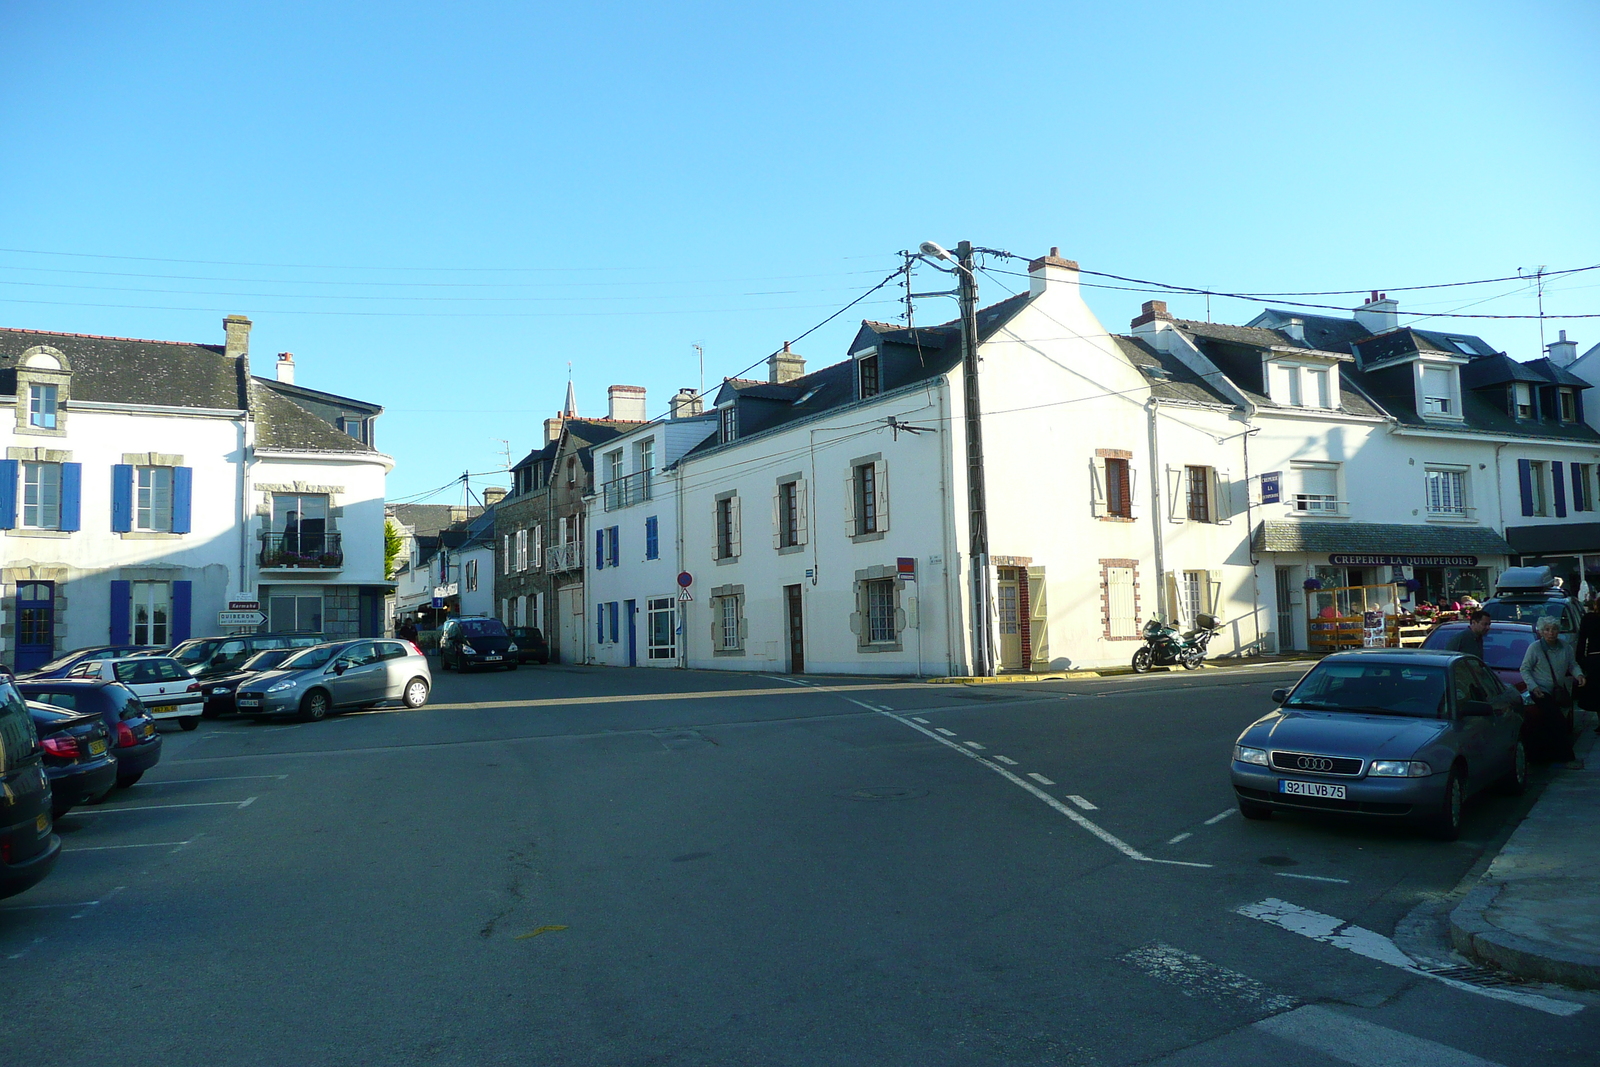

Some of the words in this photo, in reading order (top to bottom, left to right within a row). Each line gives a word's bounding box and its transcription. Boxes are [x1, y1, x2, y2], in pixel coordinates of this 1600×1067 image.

[1334, 555, 1386, 565] CREPERIE
[1390, 555, 1402, 565] LA
[1406, 556, 1474, 567] QUIMPEROISE
[1287, 782, 1305, 794] 921
[1308, 784, 1328, 796] LVB
[1330, 786, 1344, 798] 75
